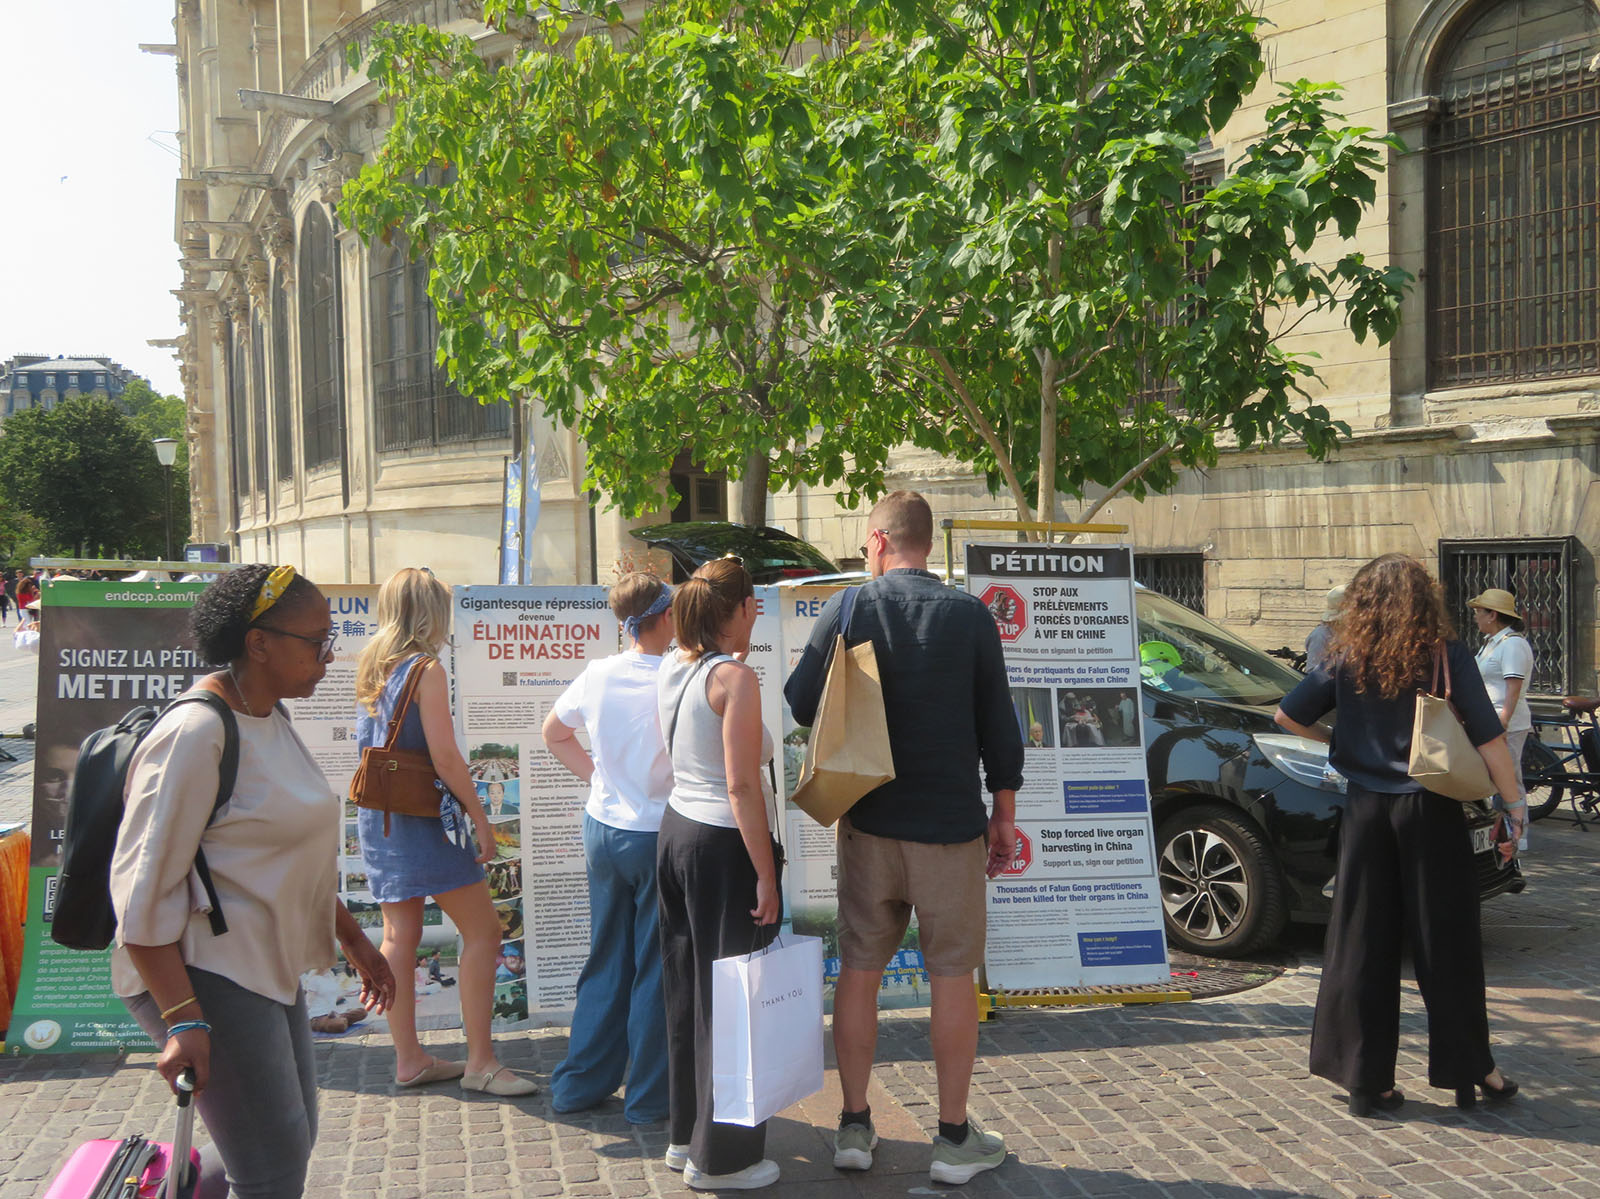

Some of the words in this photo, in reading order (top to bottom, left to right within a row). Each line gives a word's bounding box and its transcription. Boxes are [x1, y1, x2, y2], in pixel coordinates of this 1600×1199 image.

[990, 550, 1104, 573] PÉTITION
[105, 591, 200, 603] endccp.com/fr
[1033, 587, 1058, 597] STOP
[1060, 587, 1079, 597] AUX
[460, 597, 541, 611] Gigantesque
[795, 597, 829, 617] RÉ
[518, 613, 556, 622] devenue
[1034, 613, 1071, 625] FORCÉS
[1073, 615, 1130, 625] D'ORGANES
[472, 620, 600, 641] ÉLIMINATION
[996, 623, 1020, 635] TOP
[1034, 628, 1042, 639] À
[1043, 629, 1058, 639] VIF
[1061, 629, 1074, 639] EN
[1076, 629, 1106, 640] CHINE
[488, 643, 515, 660] DE
[520, 643, 586, 660] MASSE
[1050, 646, 1077, 655] signant
[59, 648, 127, 668] SIGNEZ
[133, 649, 154, 668] LA
[1023, 665, 1032, 673] de
[1033, 666, 1075, 675] pratiquants
[1076, 665, 1087, 674] du
[1088, 666, 1109, 674] Falun
[1110, 666, 1130, 675] Gong
[57, 673, 185, 700] METTRE
[1064, 677, 1094, 685] organes
[1041, 829, 1062, 840] Stop
[1064, 829, 1095, 838] forced
[1097, 828, 1114, 837] live
[1116, 829, 1144, 839] organ
[1042, 842, 1092, 853] harvesting
[1094, 842, 1104, 851] in
[1105, 841, 1133, 851] China
[1043, 859, 1072, 868] Support
[1085, 859, 1101, 867] sign
[1116, 858, 1144, 867] petition
[996, 885, 1038, 894] Thousands
[1049, 884, 1071, 892] Falun
[1072, 884, 1092, 893] Gong
[1093, 882, 1142, 892] practitioners
[992, 896, 1011, 904] have
[1012, 895, 1032, 903] been
[1033, 894, 1055, 902] killed
[1056, 893, 1068, 902] for
[1069, 894, 1087, 902] their
[1088, 894, 1116, 902] organs
[1117, 892, 1125, 900] in
[1126, 892, 1149, 900] China
[50, 958, 88, 966] personnes
[761, 994, 785, 1008] THANK
[787, 988, 804, 999] YOU
[71, 1039, 125, 1047] communiste
